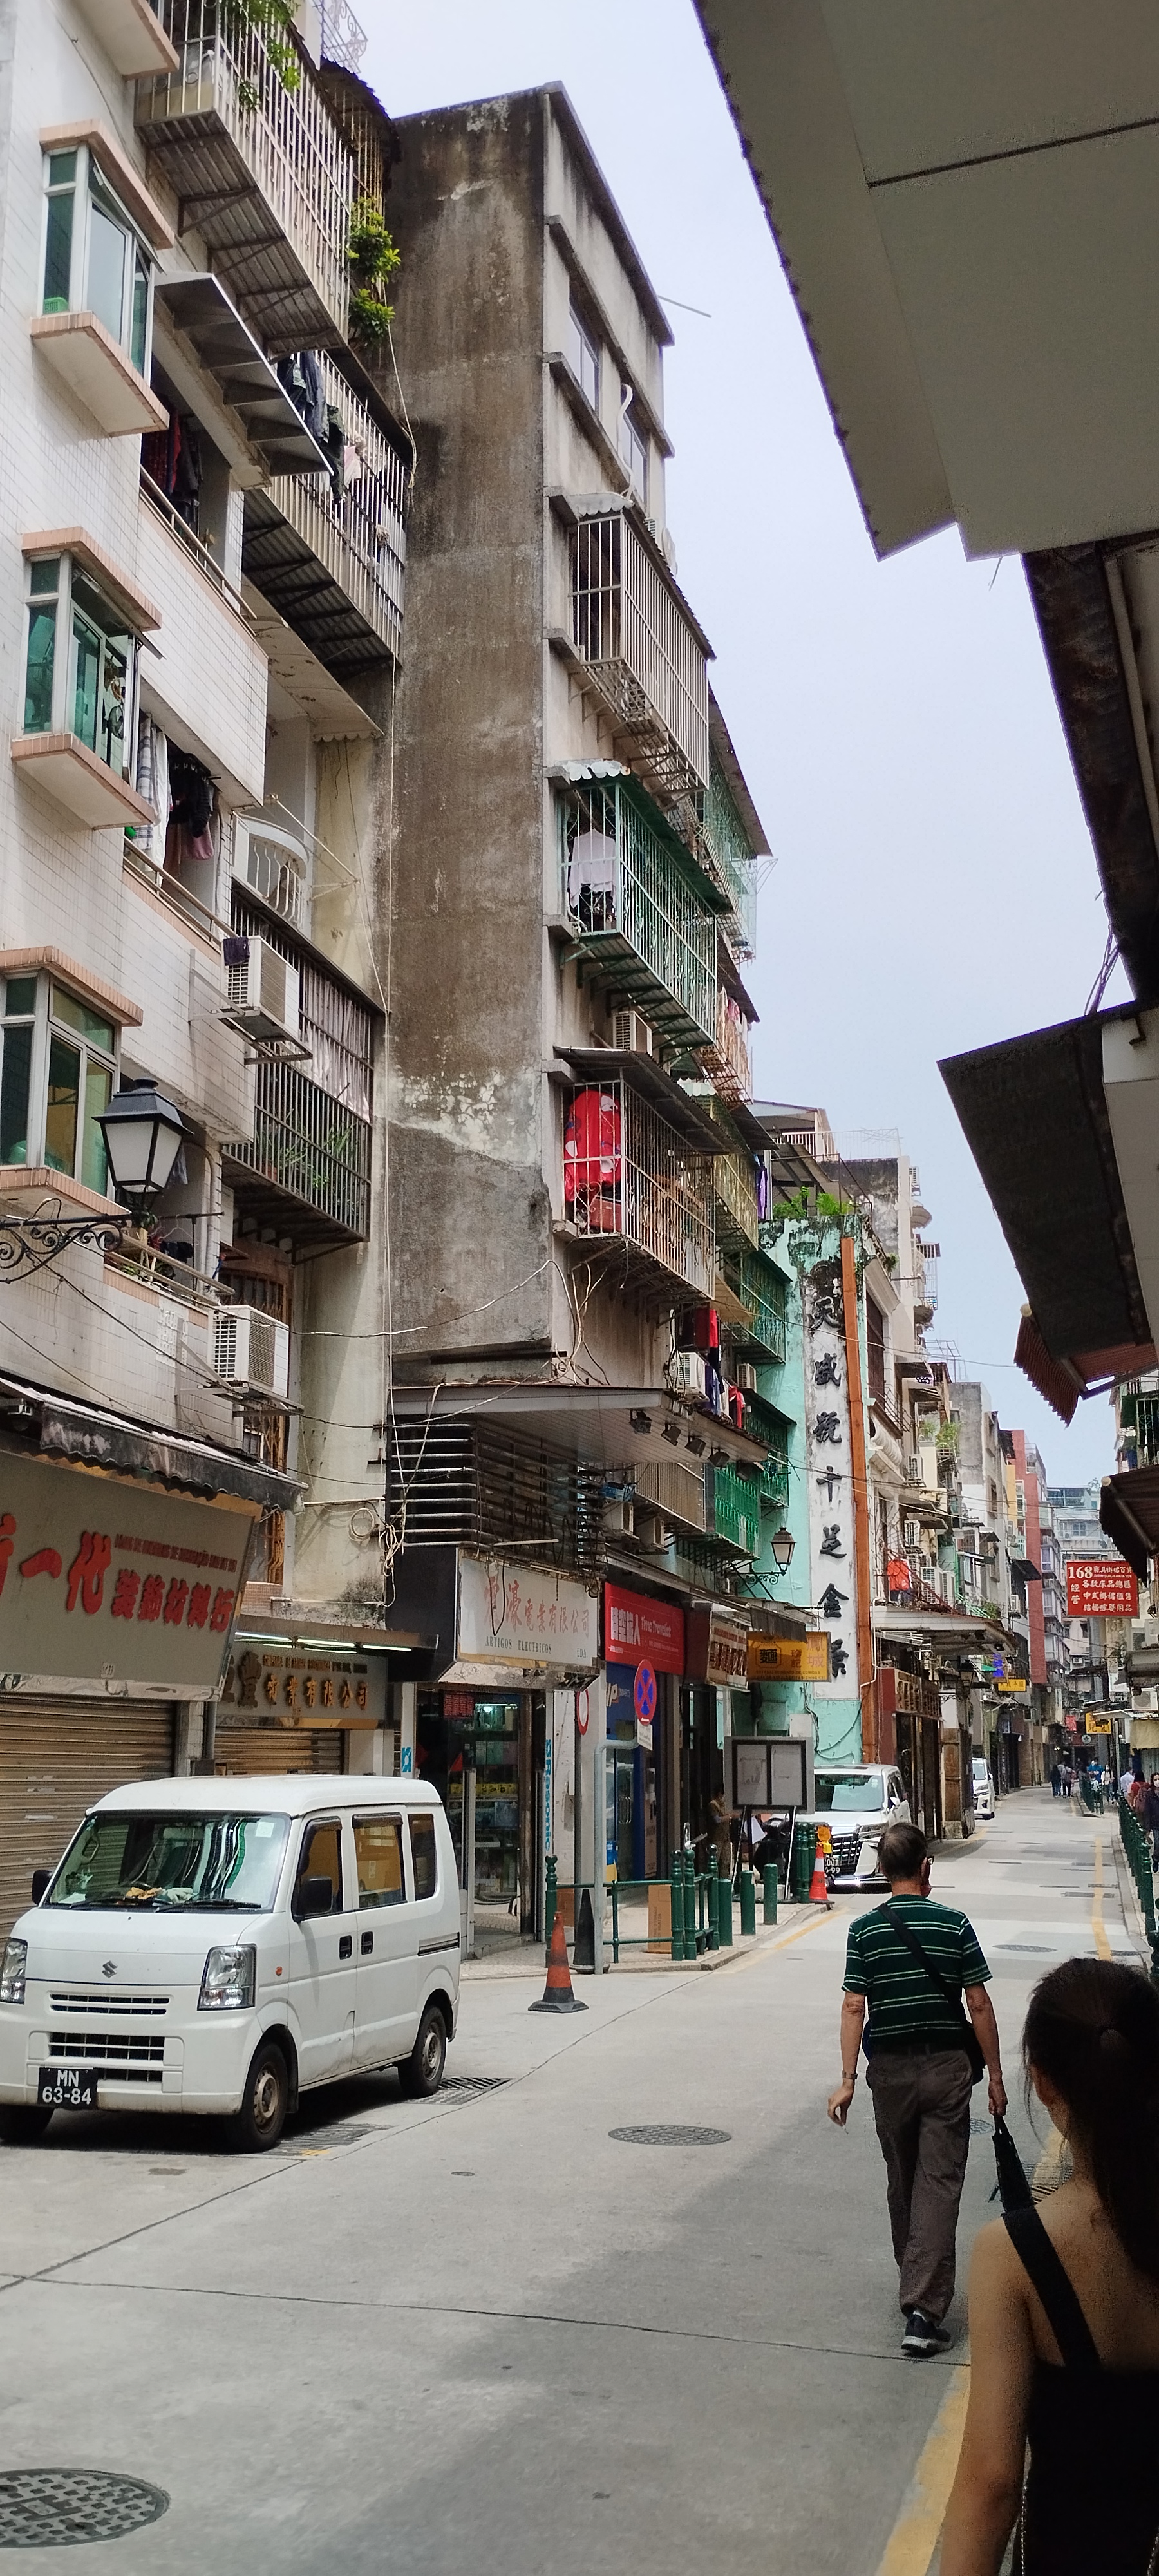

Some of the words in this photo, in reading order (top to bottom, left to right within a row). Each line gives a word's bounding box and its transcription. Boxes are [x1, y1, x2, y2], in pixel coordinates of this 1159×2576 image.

[1068, 1566, 1093, 1578] 168
[485, 1636, 513, 1649] ARTIGOS
[518, 1640, 552, 1654] ELECTRICOS
[57, 2069, 79, 2087] MN
[42, 2086, 91, 2105] 63-84
